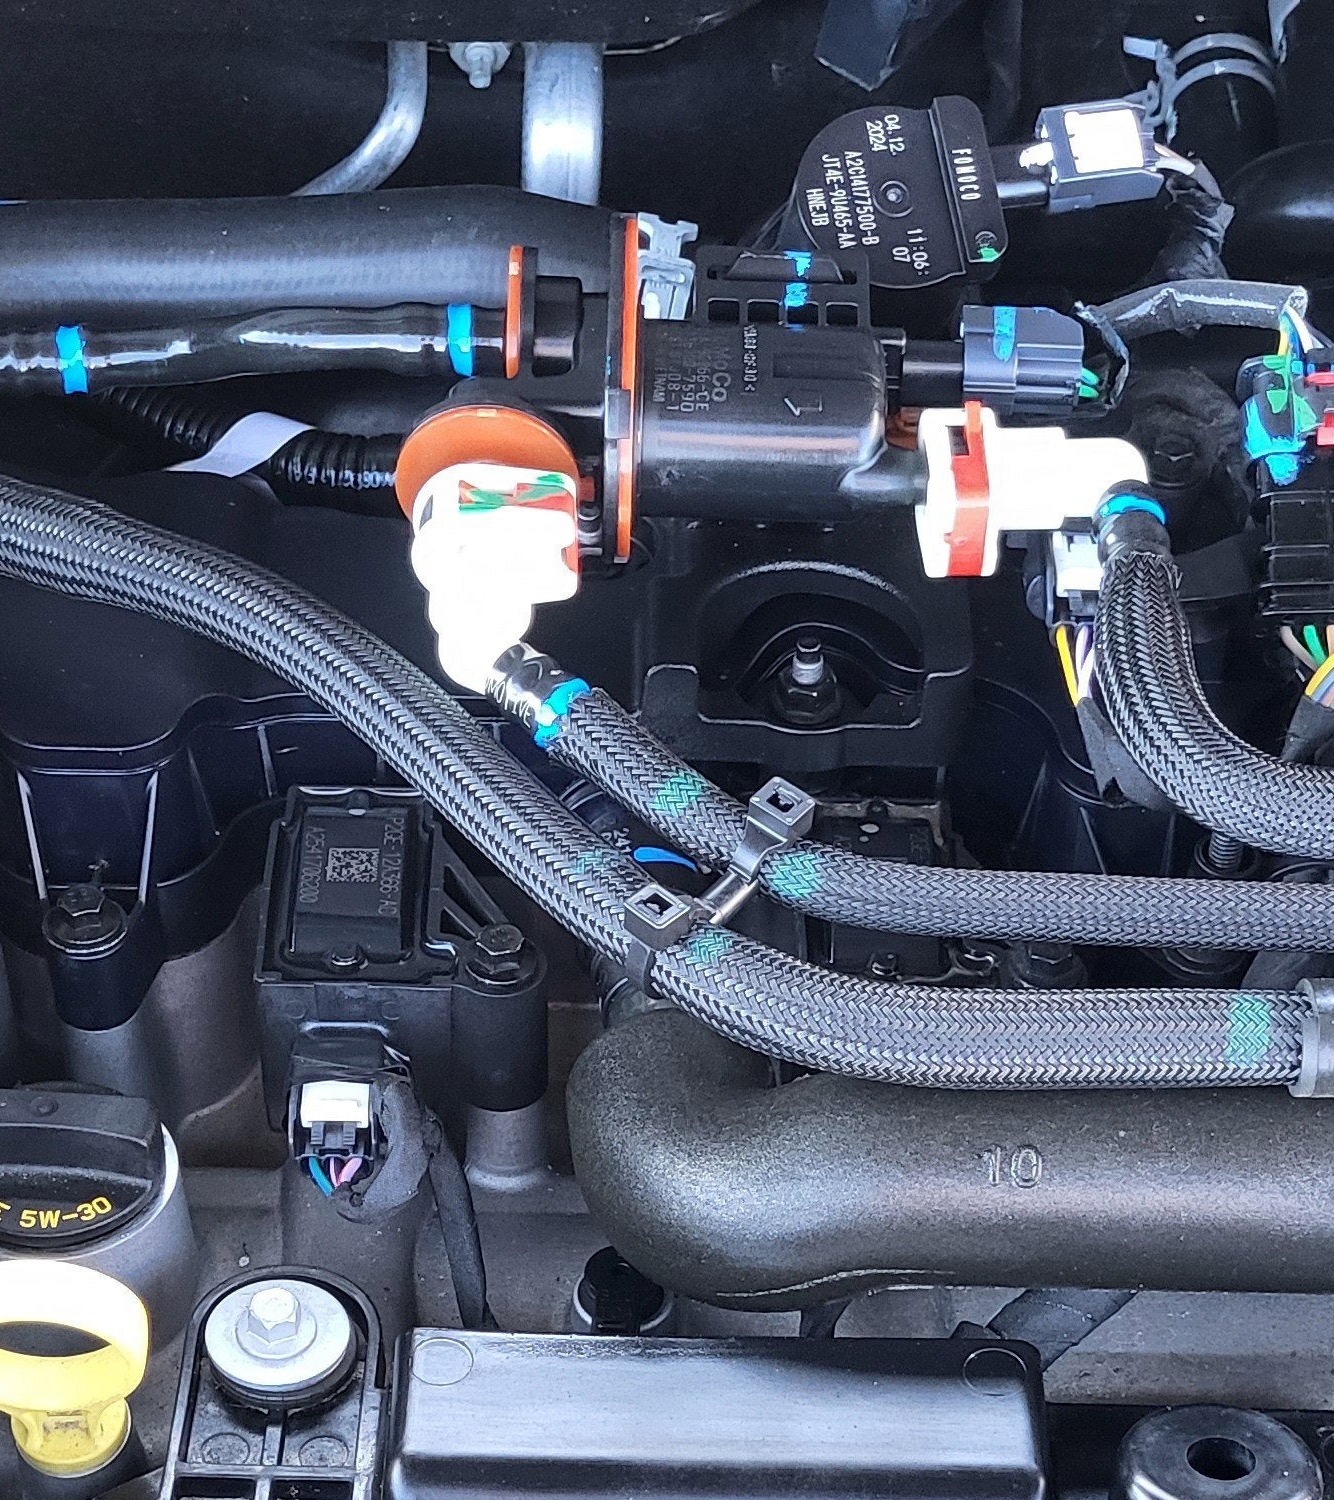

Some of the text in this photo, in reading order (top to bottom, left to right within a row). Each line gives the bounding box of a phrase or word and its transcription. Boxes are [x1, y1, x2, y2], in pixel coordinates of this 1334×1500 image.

[866, 120, 888, 152] 2024
[821, 154, 857, 250] JT4E-9U465-AA
[892, 246, 910, 263] 07
[988, 1144, 1044, 1190] 10
[19, 1195, 113, 1230] 5W-30
